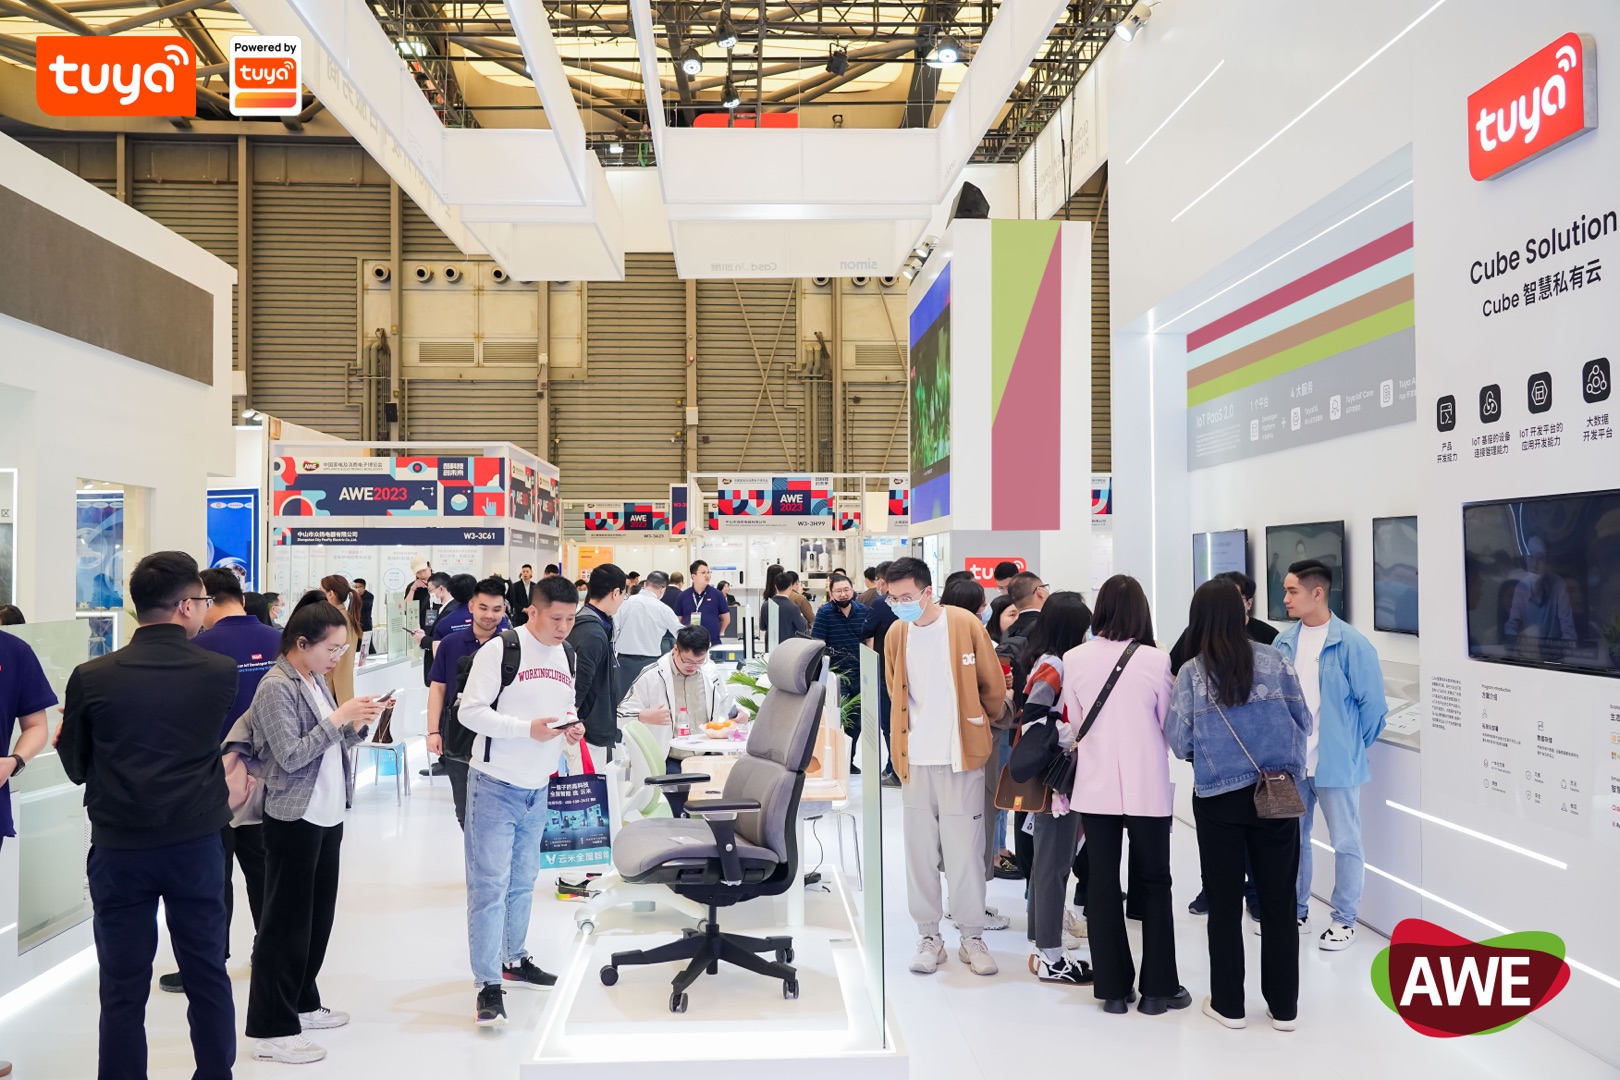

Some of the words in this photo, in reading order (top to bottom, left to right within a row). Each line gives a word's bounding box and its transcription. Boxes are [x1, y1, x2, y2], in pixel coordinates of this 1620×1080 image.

[1475, 74, 1566, 151] tuya
[1470, 250, 1520, 284] Cube
[1526, 210, 1618, 264] Solution
[1482, 291, 1520, 317] Cube
[1523, 258, 1602, 306] 智慧私有云
[1196, 413, 1206, 429] IoT
[1206, 407, 1223, 425] PaaS
[1223, 404, 1234, 420] 2.0
[1586, 413, 1609, 428] 大数据
[1519, 428, 1529, 439] IoT
[1529, 422, 1564, 437] 开发平台的
[1583, 427, 1613, 442] 开发平台
[1441, 442, 1452, 452] 产品
[1472, 437, 1481, 447] IoT
[1521, 436, 1561, 451] 应用开发能力
[1437, 452, 1458, 464] 开发能力
[339, 487, 408, 501] AWE2023
[780, 494, 803, 503] AWE
[780, 503, 803, 512] 2023
[463, 532, 496, 540] W3-3C61
[969, 563, 993, 580] tu
